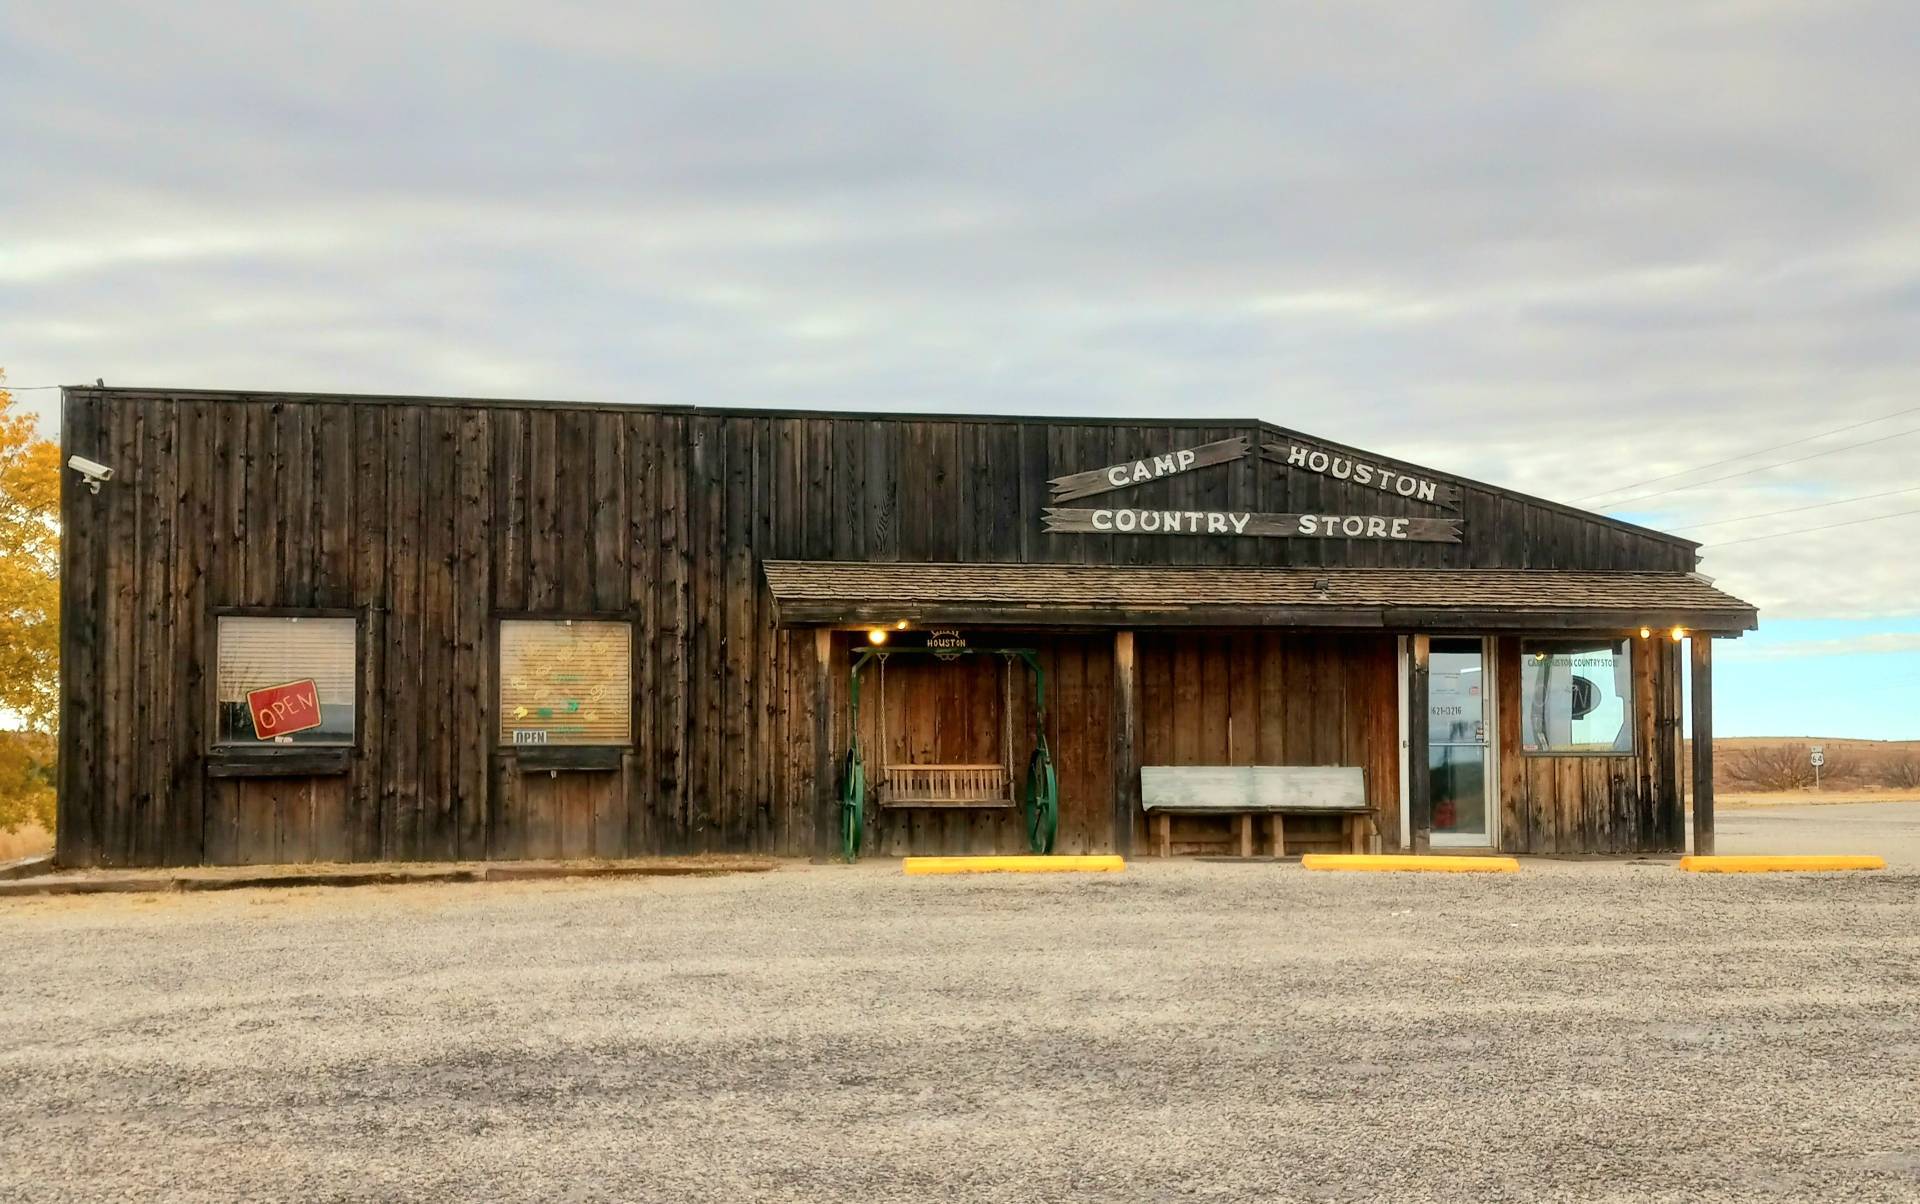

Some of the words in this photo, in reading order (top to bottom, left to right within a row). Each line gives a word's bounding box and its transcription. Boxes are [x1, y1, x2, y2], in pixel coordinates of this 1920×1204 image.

[1107, 449, 1196, 487] CAMP
[1287, 446, 1437, 501] HOUSTON
[1091, 509, 1251, 534] COUNTRY
[1298, 514, 1410, 539] STORE
[927, 639, 966, 648] HOUSTON
[1573, 658, 1600, 668] COUNTRY
[259, 692, 314, 729] OPEN
[515, 731, 546, 744] OPEN
[1812, 754, 1822, 763] 64
